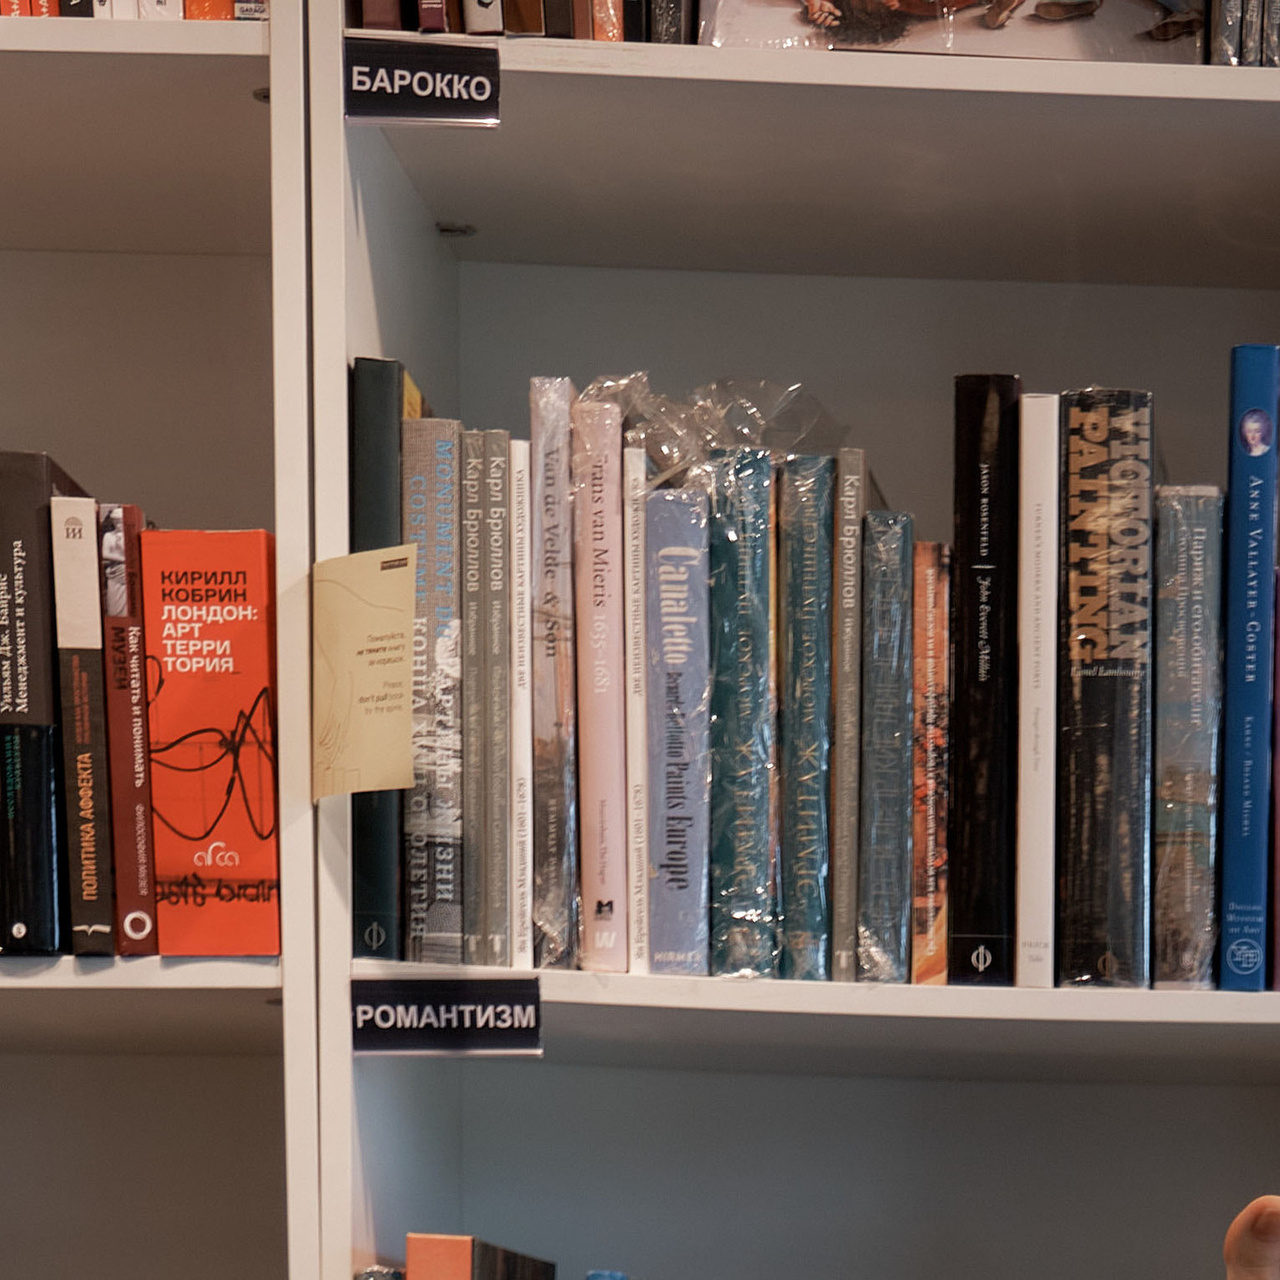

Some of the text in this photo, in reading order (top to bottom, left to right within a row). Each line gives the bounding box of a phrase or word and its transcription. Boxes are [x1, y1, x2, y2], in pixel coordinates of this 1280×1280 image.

[352, 65, 491, 101] БАРОККО
[487, 456, 506, 501] Карл
[434, 440, 453, 596] MONUMENT
[465, 457, 483, 592] Карл Брюллов
[543, 495, 560, 518] de
[1068, 400, 1108, 660] PAINTING
[488, 508, 506, 591] Брюллов
[542, 524, 562, 580] Velde
[840, 474, 861, 609] Карл Брюллов
[1108, 407, 1149, 665] VICTORIAN
[161, 571, 246, 585] КИРИЛЛ
[161, 588, 246, 602] КОБРИН
[12, 540, 28, 713] Менеджмент и культура
[161, 605, 257, 624] ЛОНДОН:
[162, 622, 201, 638] АРТ
[542, 619, 562, 659] Son
[162, 640, 230, 655] ТЕРРИ
[127, 626, 146, 788] Как читать и понимать
[76, 752, 98, 901] ПОЛИТИКА АФФЕКТА
[356, 1004, 536, 1029] РОМАНТИЗМ
